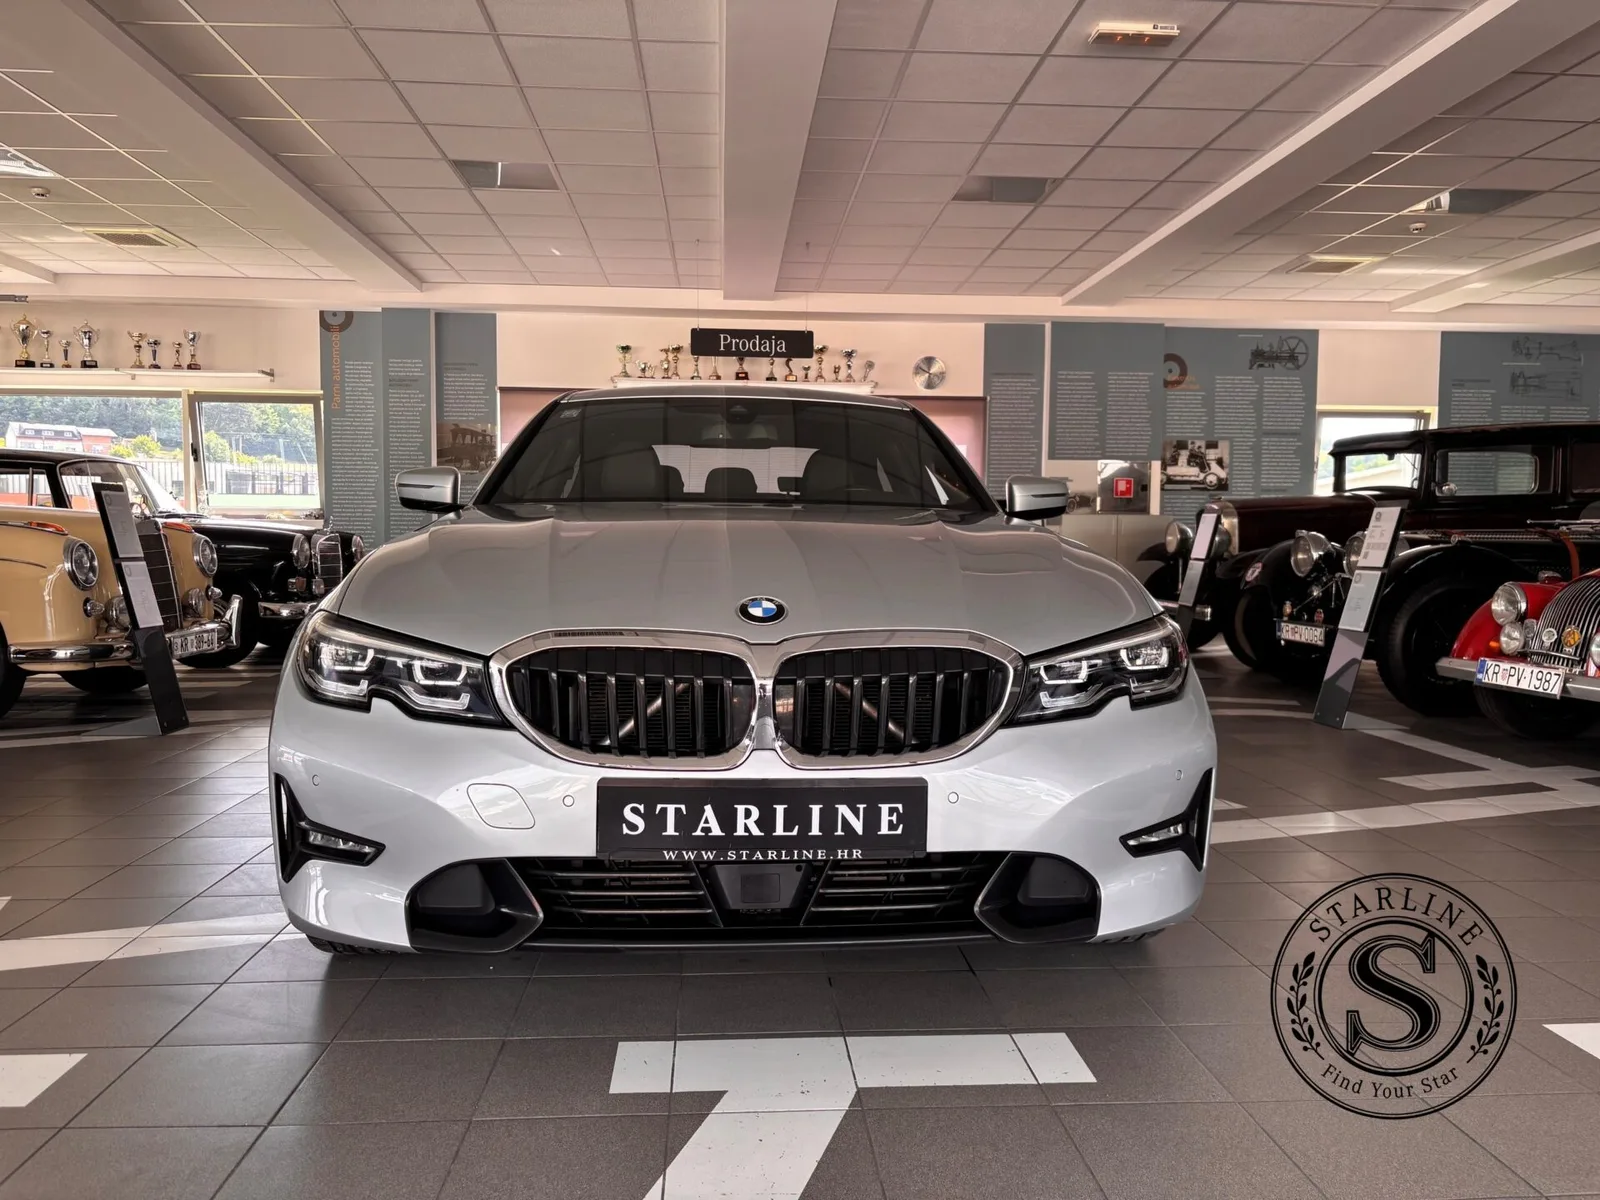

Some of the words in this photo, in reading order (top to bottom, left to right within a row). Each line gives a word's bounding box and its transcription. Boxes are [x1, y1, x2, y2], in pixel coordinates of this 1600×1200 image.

[719, 333, 787, 356] Prodaja
[331, 382, 341, 409] Parni
[1483, 662, 1501, 683] KR
[622, 803, 903, 836] STARLINE
[663, 849, 863, 860] WWW.STARLINE.HR
